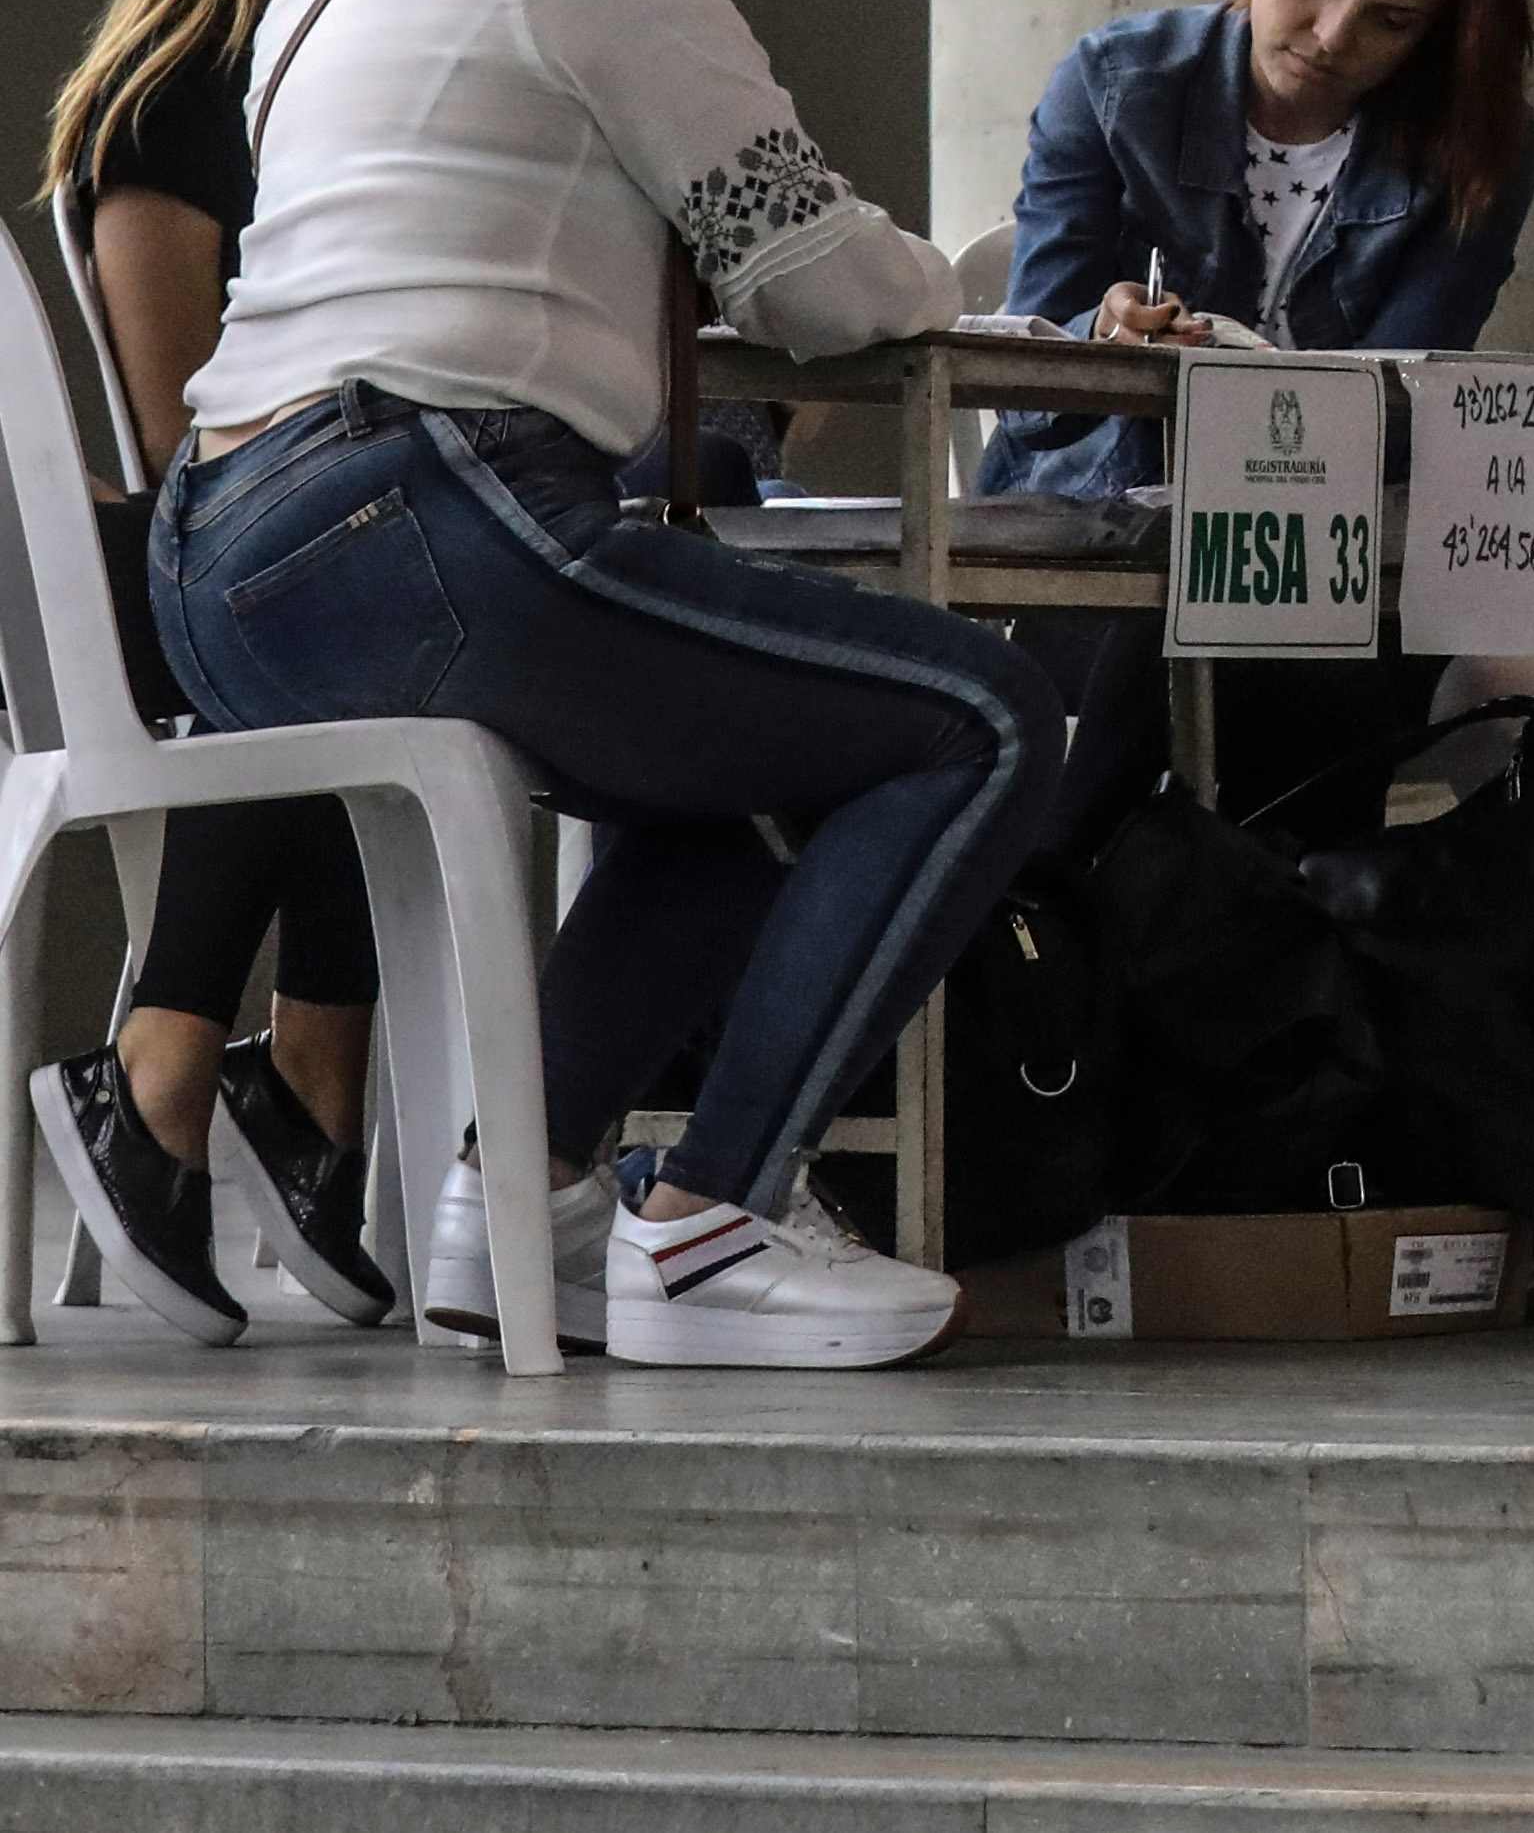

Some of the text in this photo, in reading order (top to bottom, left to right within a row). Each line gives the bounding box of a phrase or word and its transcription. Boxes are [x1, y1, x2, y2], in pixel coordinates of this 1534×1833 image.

[1486, 455, 1500, 495] A
[1187, 511, 1370, 606] MESA 33
